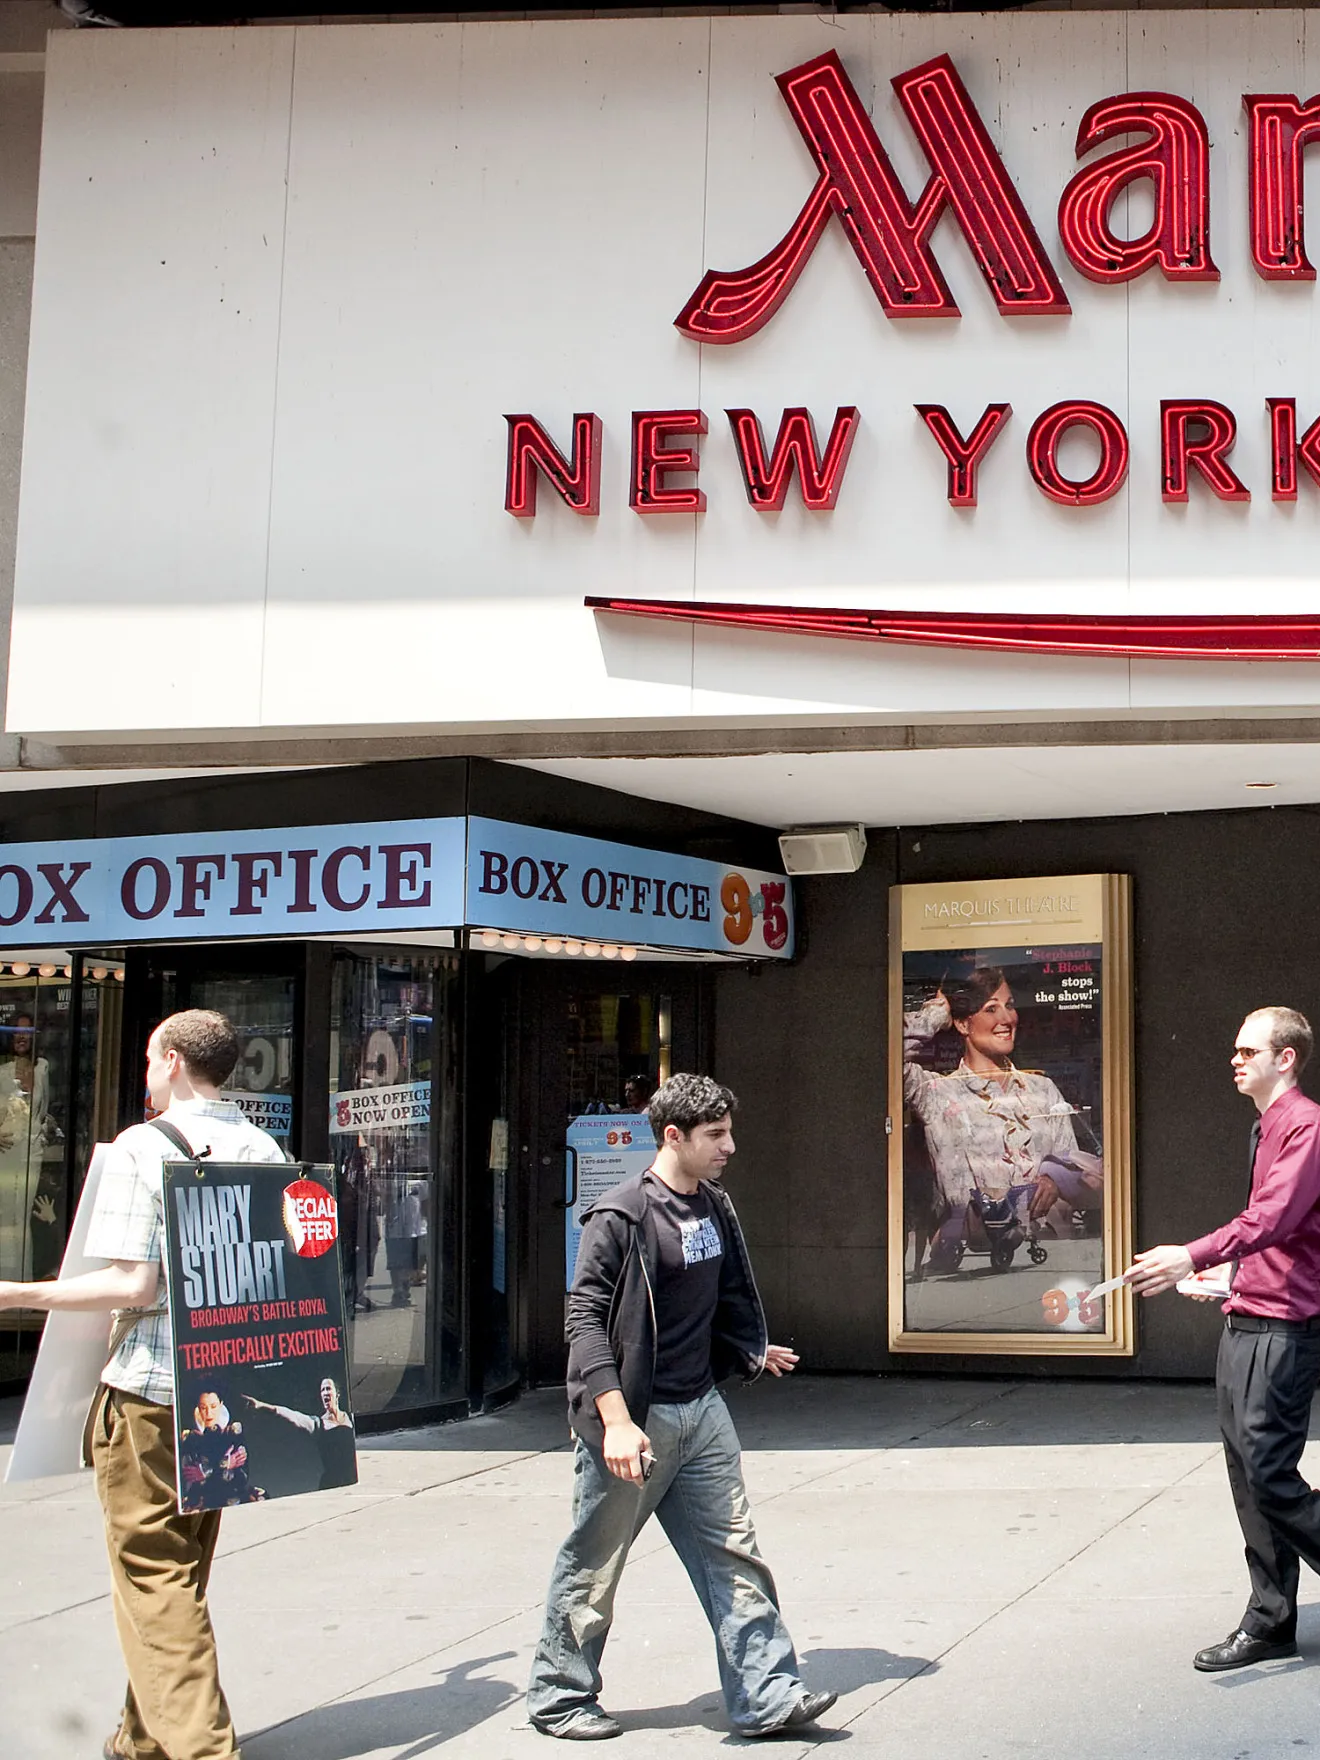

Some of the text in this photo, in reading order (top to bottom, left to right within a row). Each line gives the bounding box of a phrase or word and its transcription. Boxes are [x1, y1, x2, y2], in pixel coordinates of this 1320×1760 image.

[503, 405, 860, 517] NEW
[0, 842, 431, 926] OX OFFICE
[479, 850, 711, 923] BOX OFFICE
[924, 900, 1000, 918] MARQUIS
[1057, 961, 1093, 973] Block
[1061, 977, 1093, 988] stops
[1035, 991, 1055, 1002] the
[352, 1094, 380, 1109] BOX
[383, 1089, 431, 1107] OFFICE
[352, 1104, 431, 1124] NOW OPEN
[175, 1185, 251, 1248] MARY
[300, 1220, 334, 1241] FFER
[180, 1239, 286, 1308] STUART
[190, 1298, 328, 1329] BROADWAY'S BATTLE ROYAL
